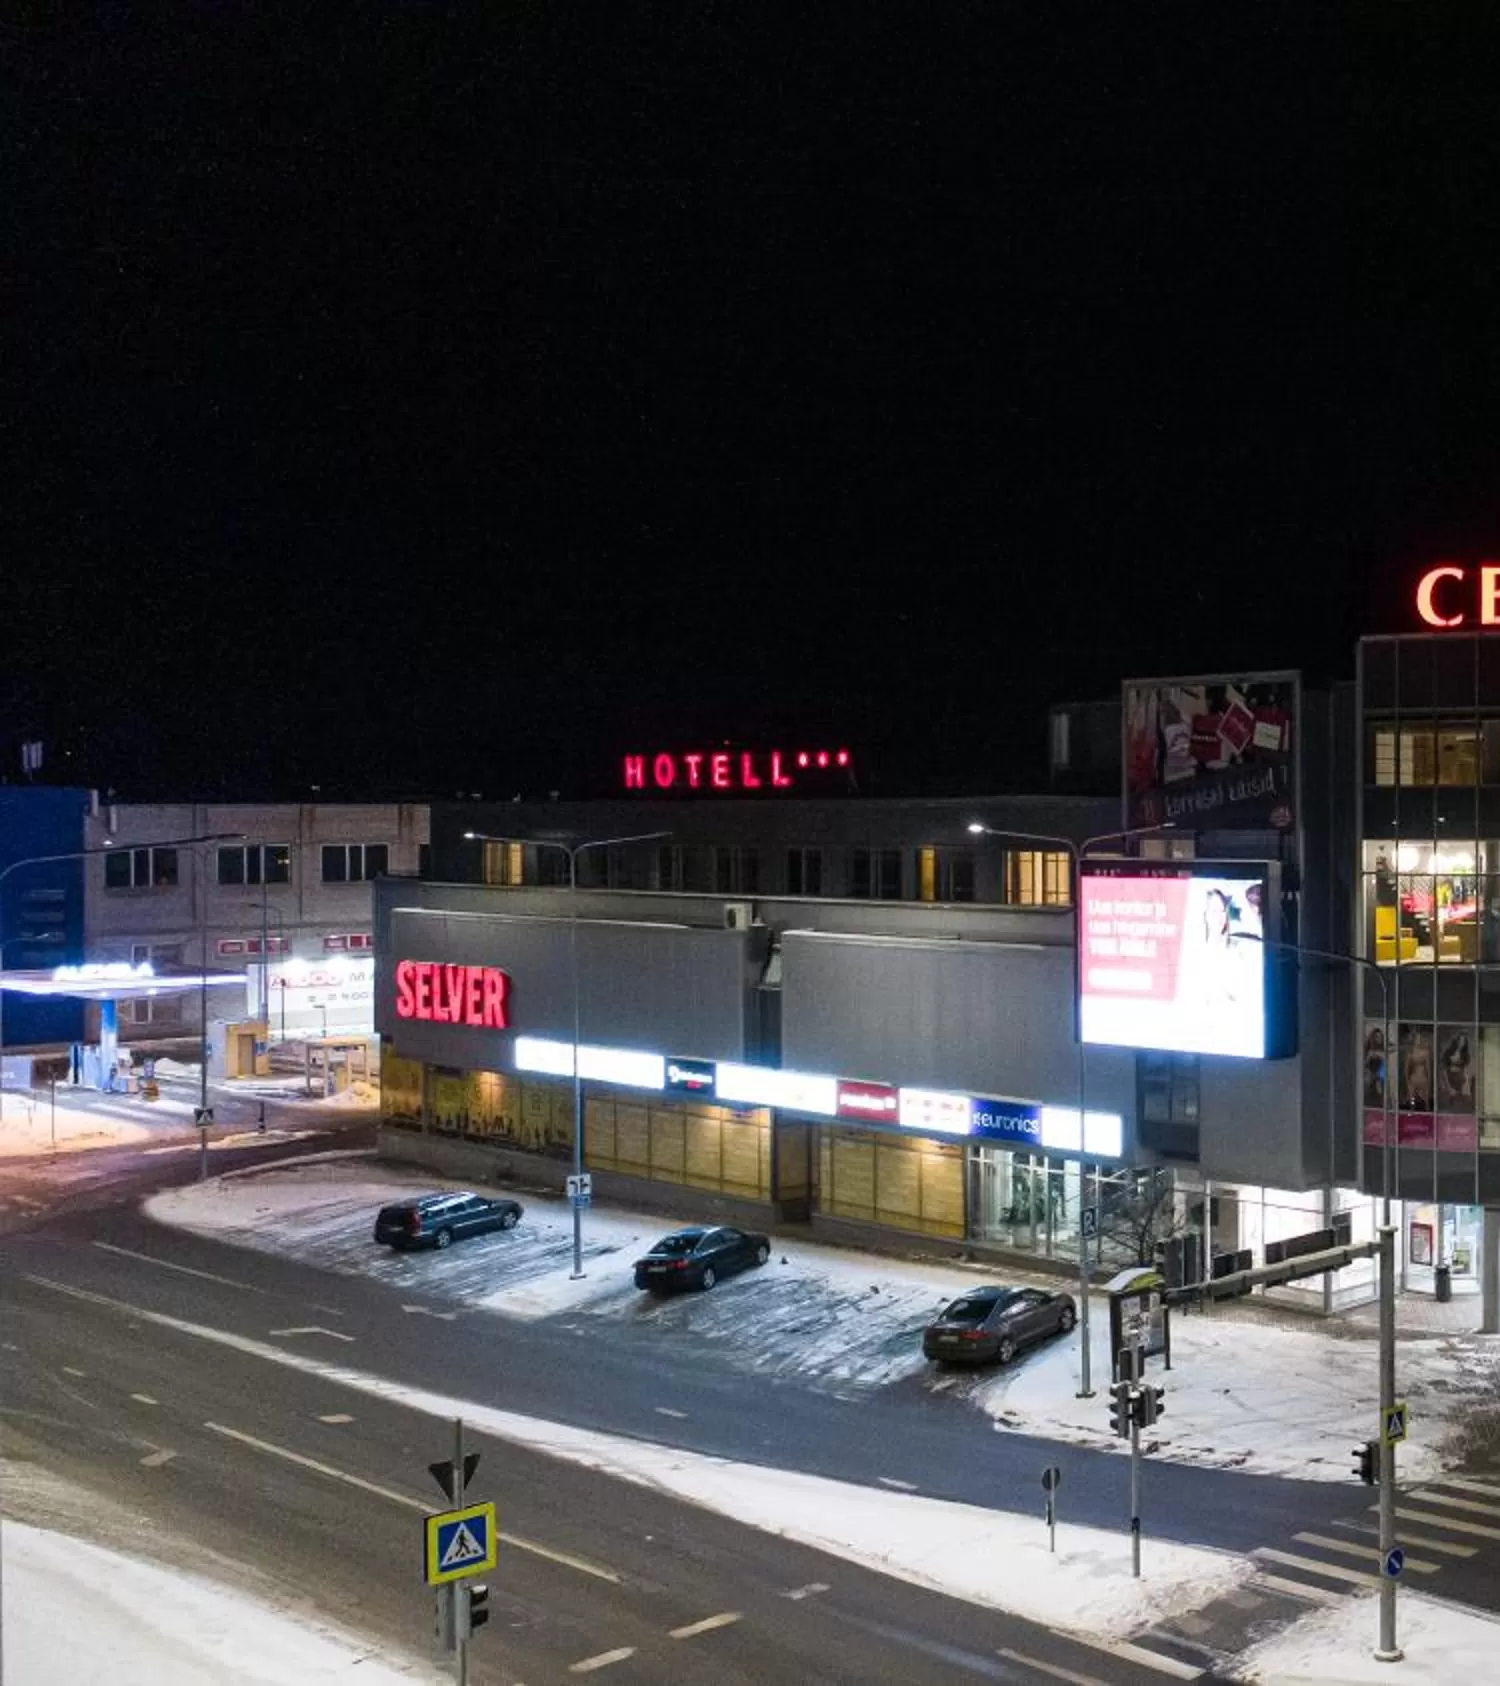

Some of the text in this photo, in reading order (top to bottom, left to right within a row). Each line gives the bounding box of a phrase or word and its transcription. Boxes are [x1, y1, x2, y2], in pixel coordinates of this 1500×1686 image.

[624, 752, 792, 788] HOTELL
[395, 959, 508, 1030] SELVER
[981, 1112, 1041, 1135] euronics
